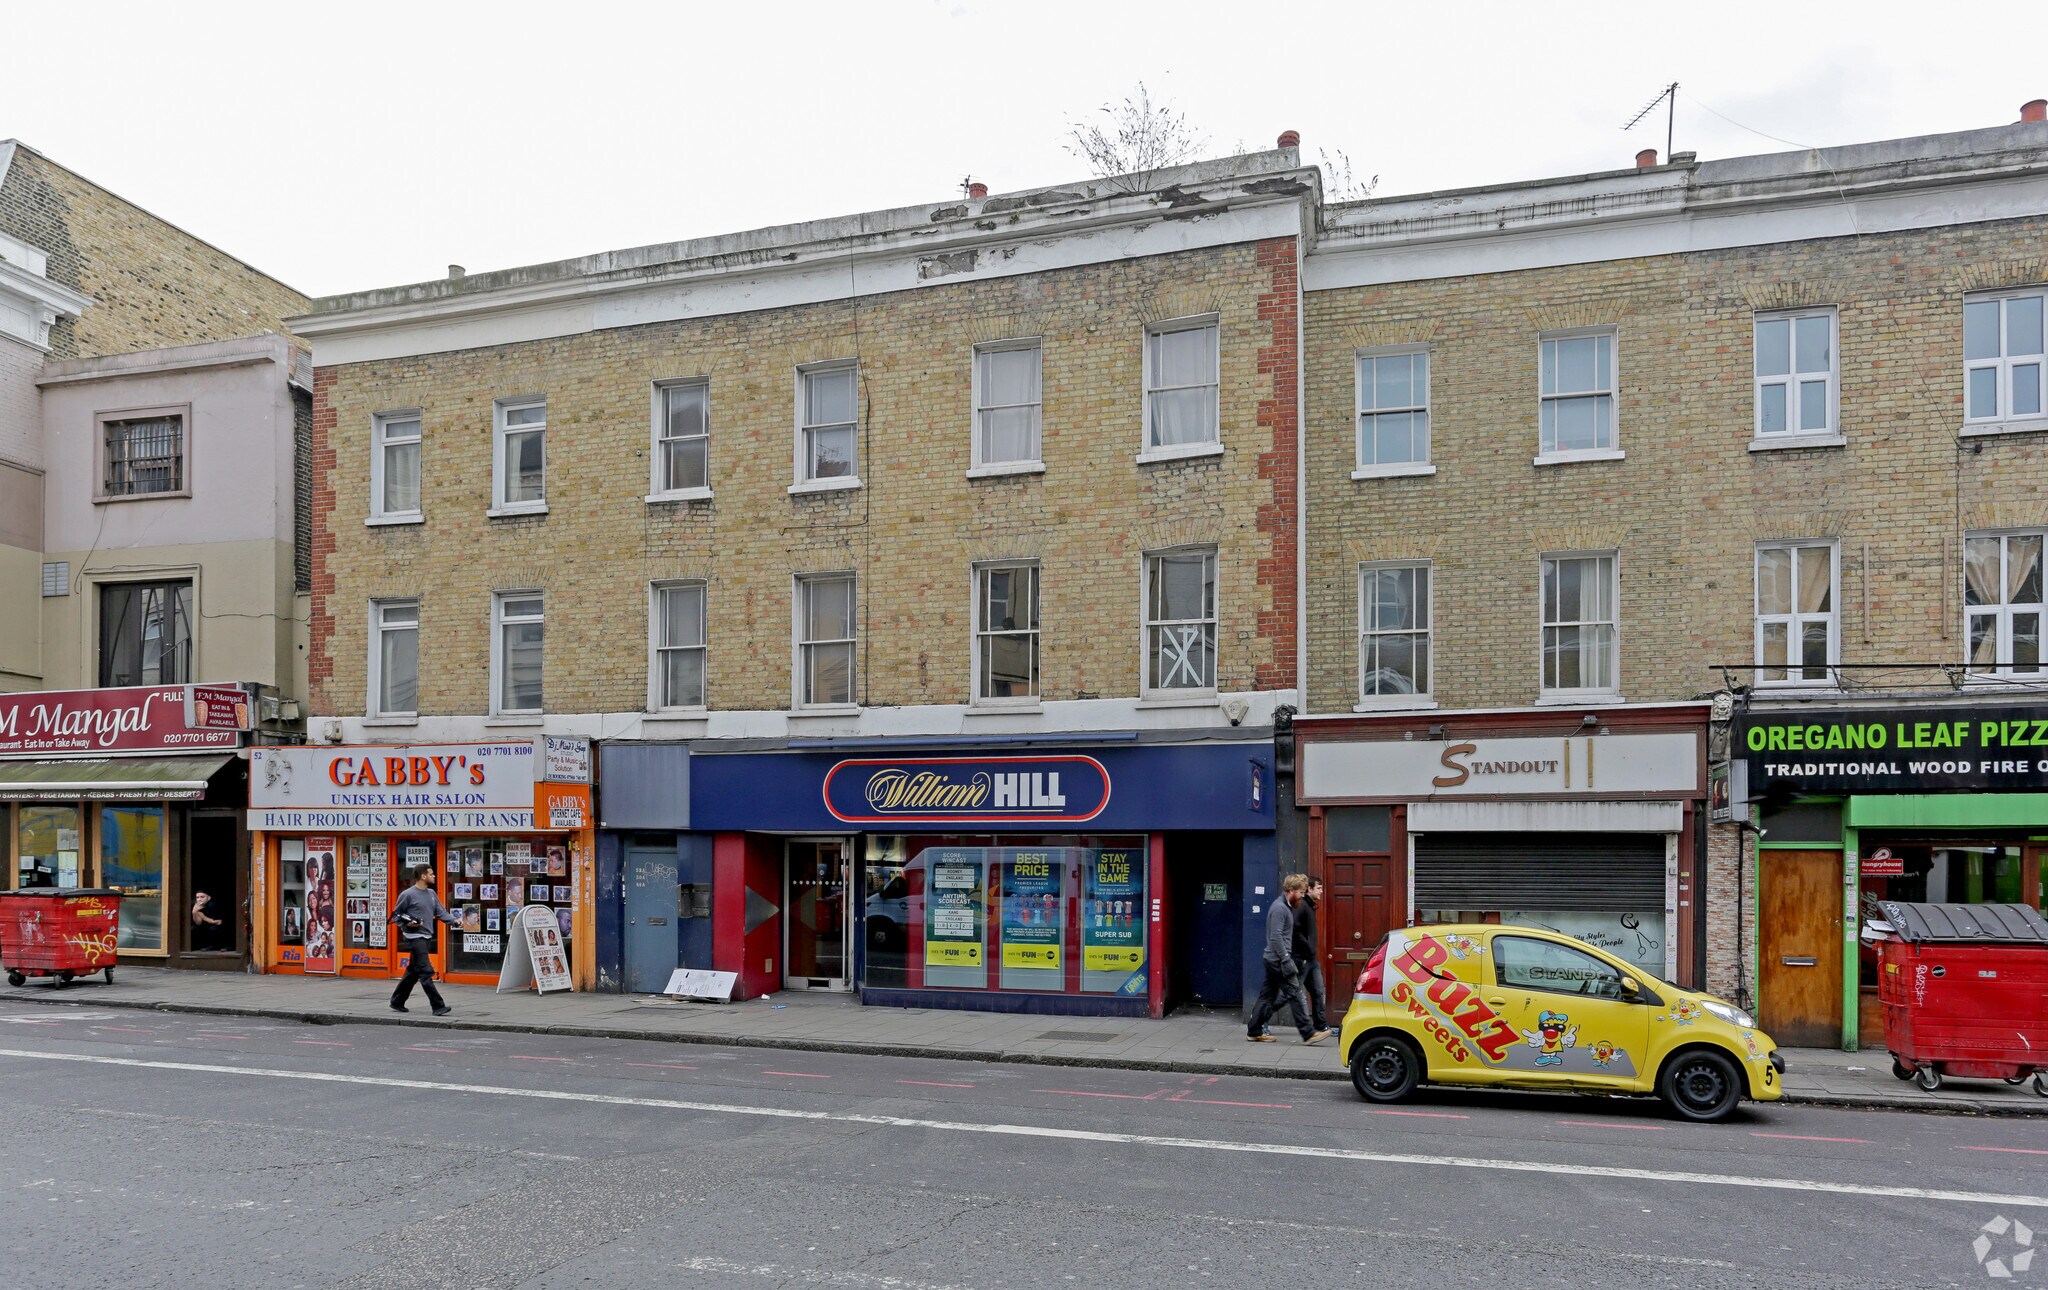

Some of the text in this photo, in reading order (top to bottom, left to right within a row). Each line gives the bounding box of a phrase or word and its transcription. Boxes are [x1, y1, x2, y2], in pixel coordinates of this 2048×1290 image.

[163, 691, 184, 702] FULL
[214, 692, 245, 704] Mangal
[26, 692, 160, 747] Mangal
[164, 732, 230, 743] 020 7701 6677
[1747, 723, 1888, 751] OREGANO
[1897, 721, 1970, 748] LEAF
[25, 739, 38, 748] Eat
[54, 738, 70, 748] Take
[71, 737, 90, 749] Away
[477, 747, 532, 756] 020 7701 8100
[548, 755, 559, 764] Party
[1432, 743, 1559, 787] STANDOUT
[328, 755, 485, 787] GABBY's
[1764, 761, 1902, 777] TRADITIONAL
[1908, 760, 1972, 774] WOOD
[1980, 760, 2029, 774] FIRE
[865, 768, 1066, 809] William HILL
[331, 794, 486, 805] UNISEX HAIR SALON
[548, 795, 586, 808] GABBY's
[551, 809, 581, 818] INTERNET CAFE
[265, 813, 302, 826] HAIR
[307, 813, 383, 827] PRODUCTS
[386, 813, 398, 827] &
[402, 813, 462, 827] MONEY
[1016, 853, 1048, 864] BEST
[1101, 853, 1127, 863] STAY
[1014, 864, 1049, 876] PRICE
[1097, 863, 1130, 873] IN THE
[1099, 873, 1129, 883] GAME
[465, 935, 500, 944] INTERNET CAFE
[282, 951, 301, 960] Ria
[351, 955, 370, 964] Ria
[1765, 1065, 1773, 1087] 5
